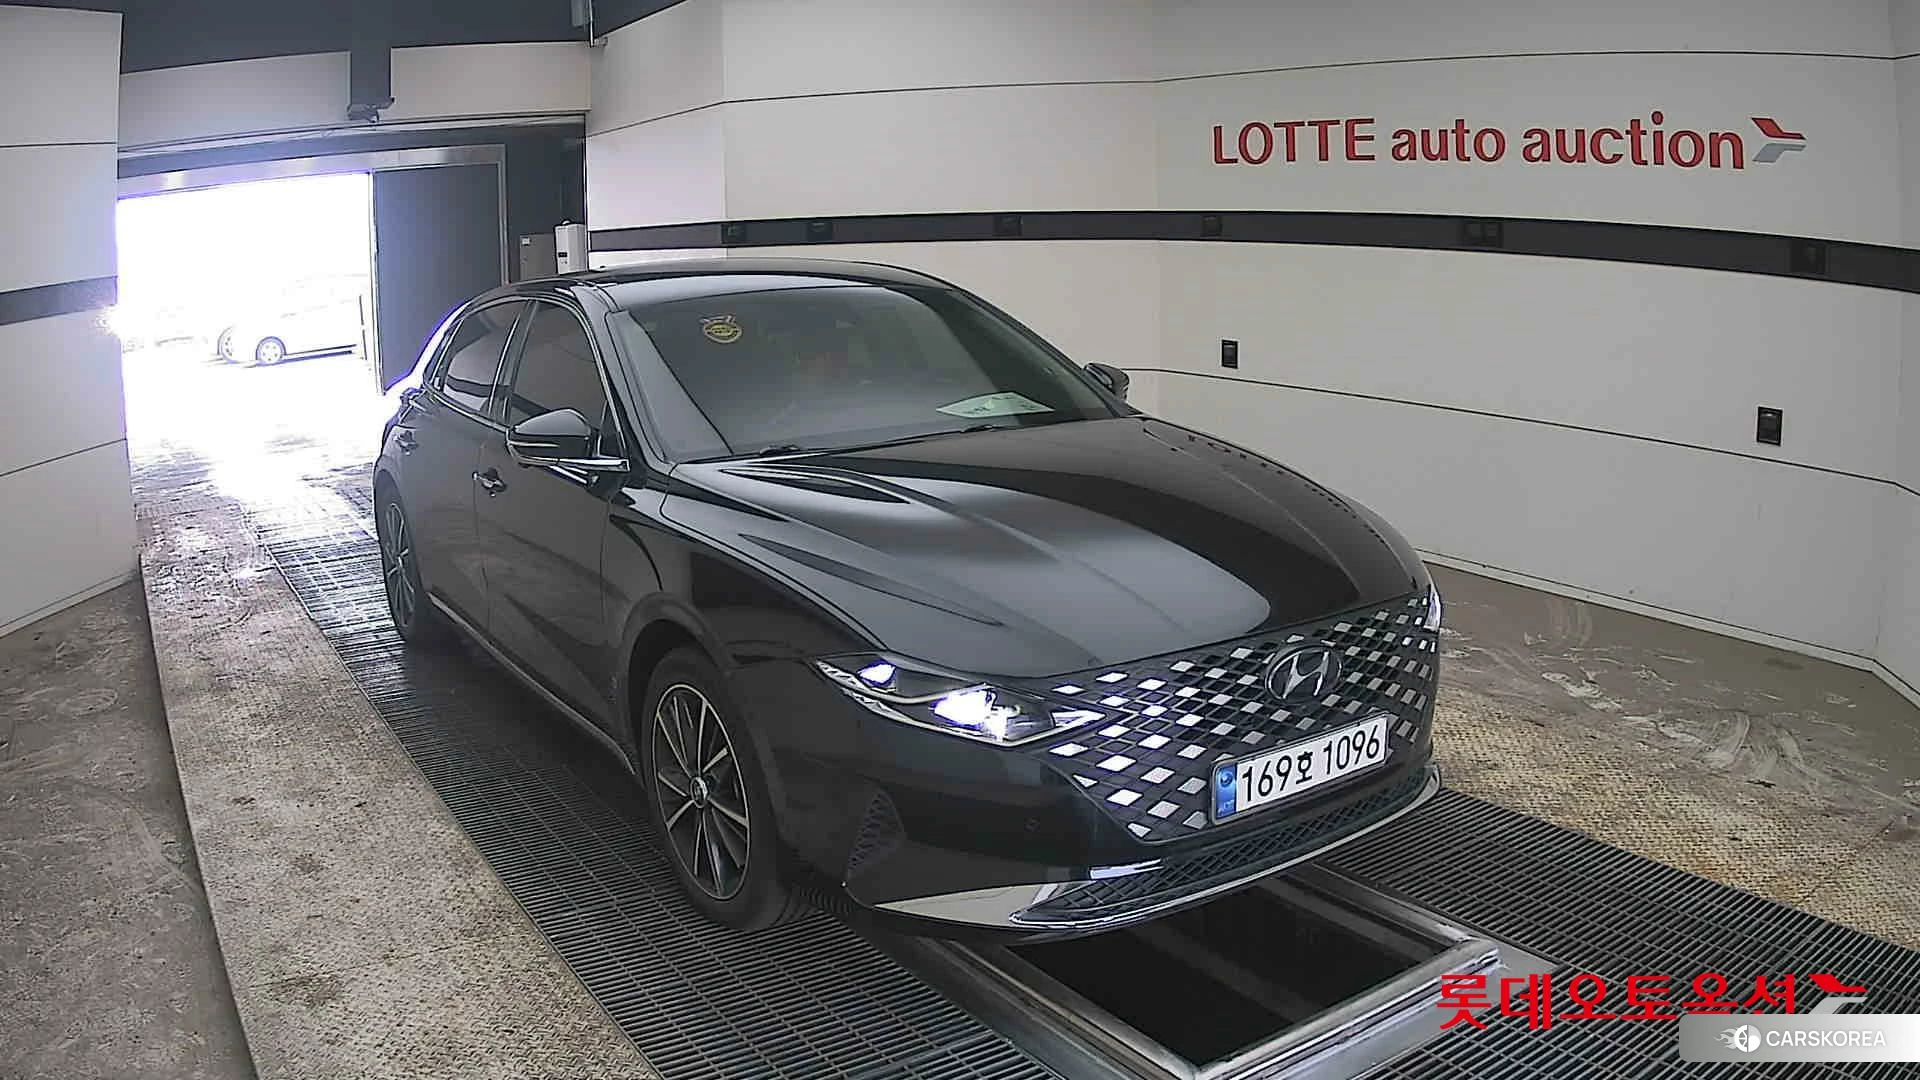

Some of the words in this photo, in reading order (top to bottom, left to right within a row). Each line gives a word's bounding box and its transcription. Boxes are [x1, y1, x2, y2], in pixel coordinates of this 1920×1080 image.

[1213, 118, 1375, 165] LOTTE
[1391, 118, 1506, 163] auto
[1522, 110, 1746, 170] auction
[1242, 751, 1314, 802] 169호
[1323, 725, 1380, 775] 1096
